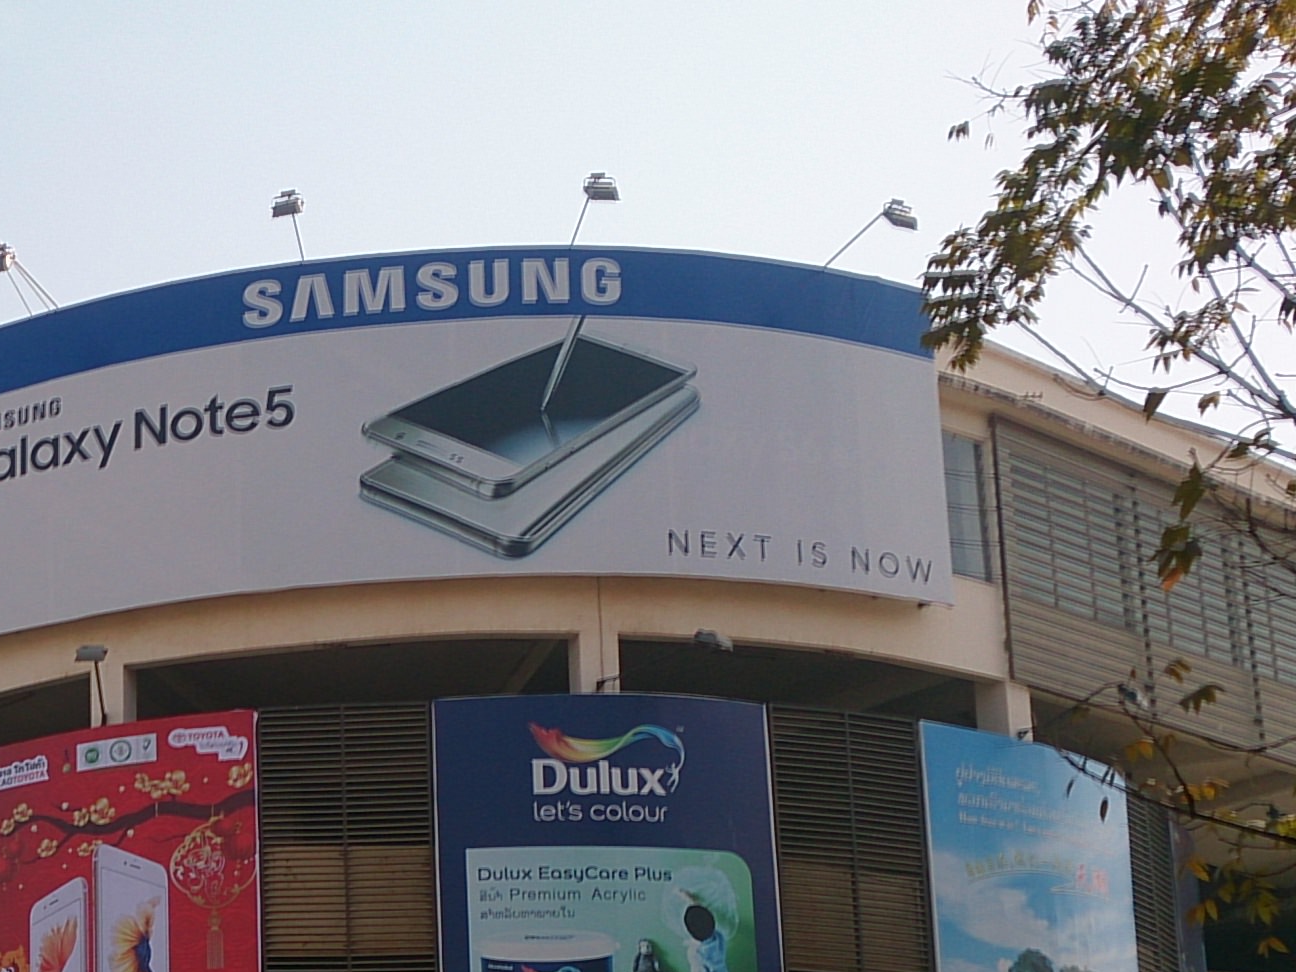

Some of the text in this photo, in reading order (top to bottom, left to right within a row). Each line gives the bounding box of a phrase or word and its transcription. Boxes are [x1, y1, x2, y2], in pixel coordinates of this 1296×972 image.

[240, 256, 623, 328] SAMSUNG
[132, 386, 295, 450] Note5
[667, 529, 935, 584] NEXT IS NOW
[531, 758, 666, 796] Dulux
[533, 800, 668, 823] let's colour
[478, 866, 673, 883] Dulux EasyCare Plus
[510, 888, 581, 901] Premium
[591, 887, 646, 904] Acrylic
